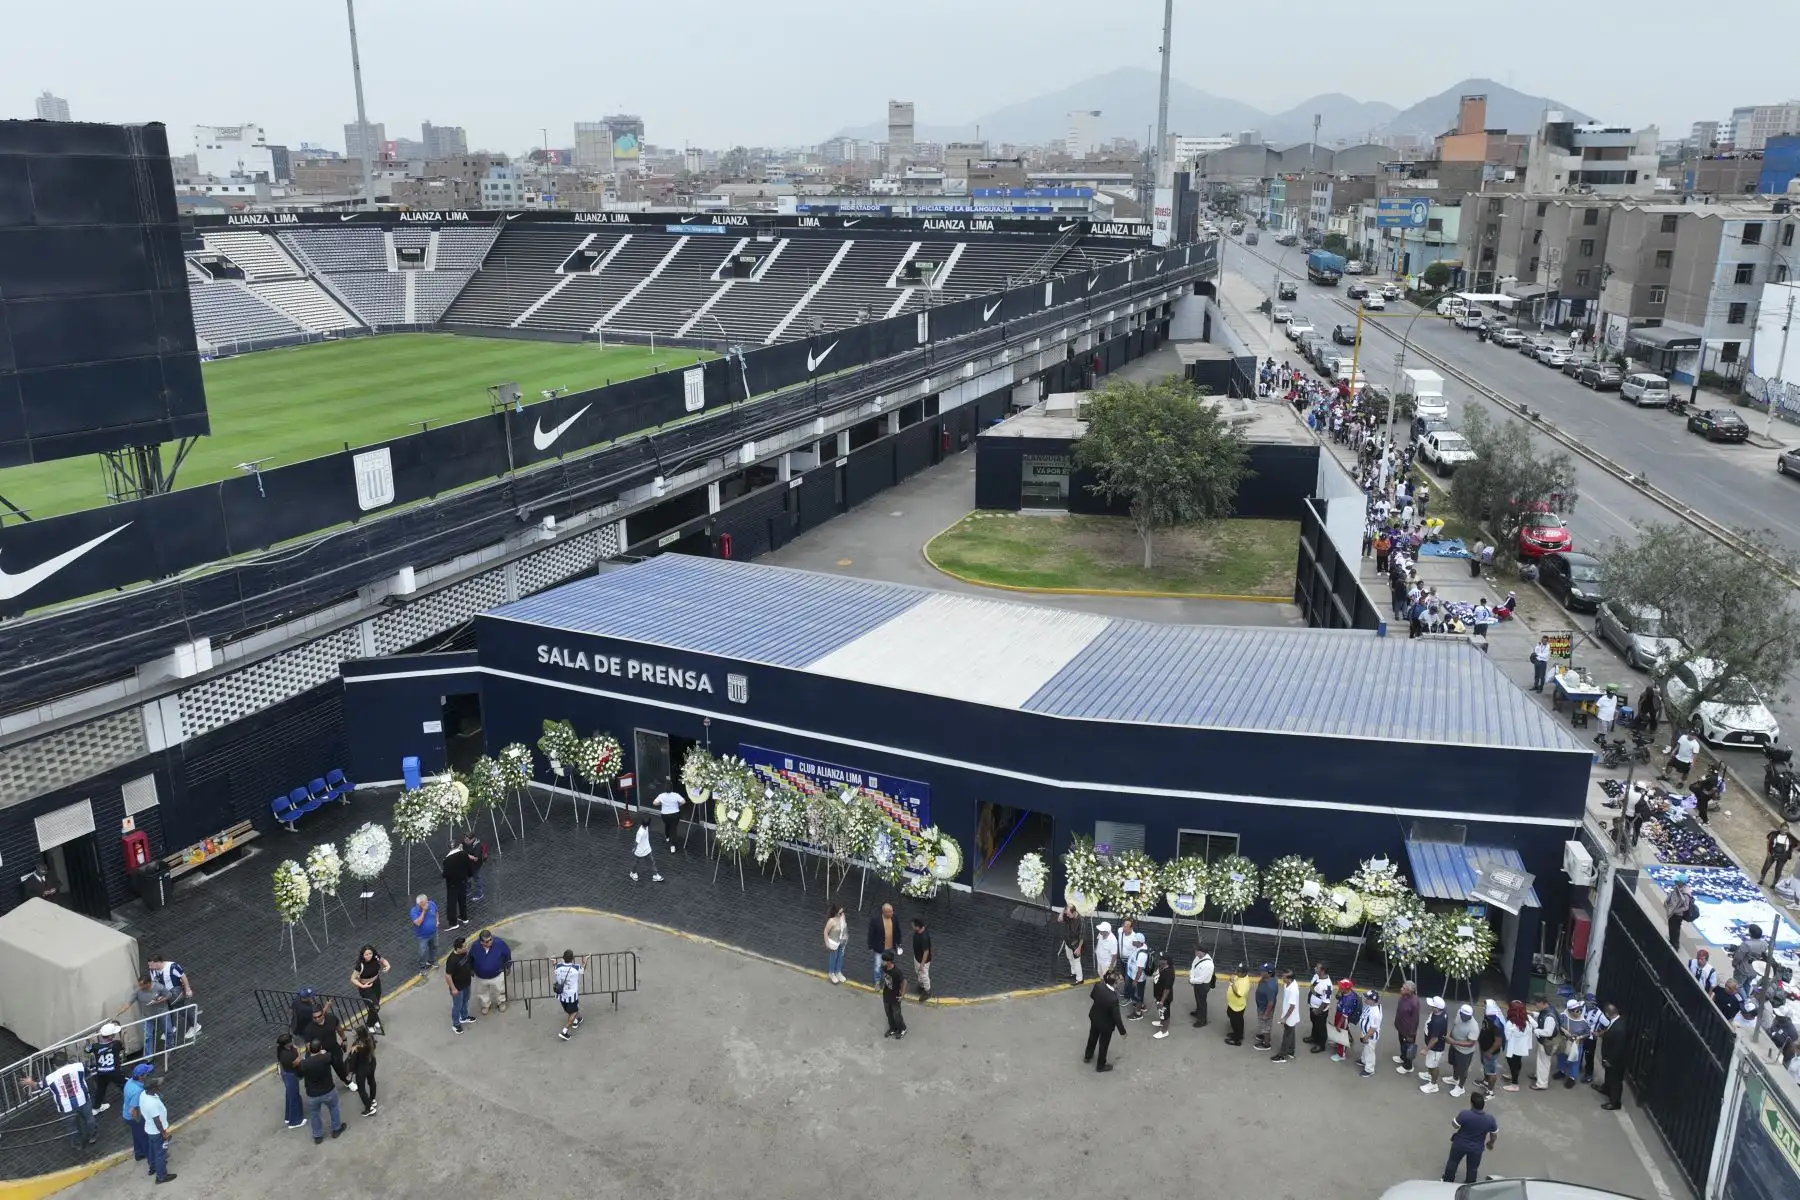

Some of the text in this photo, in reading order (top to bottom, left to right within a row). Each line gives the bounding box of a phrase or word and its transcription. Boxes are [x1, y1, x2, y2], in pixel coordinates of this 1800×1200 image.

[228, 213, 299, 225] ALIANZA LIMA
[400, 211, 469, 221] ALIANZA LIMA
[574, 213, 631, 223] ALIANZA LIMA
[711, 215, 820, 227] ALIANZA LIMA
[922, 219, 995, 231] ALIANZA LIMA
[1090, 223, 1152, 236] ALIANZA LIMA
[537, 644, 590, 671] SALA
[593, 653, 622, 677] DE
[627, 658, 715, 695] PRENSA
[799, 761, 863, 785] CLUB ALIANZA LIMA
[98, 1053, 114, 1067] 48
[1775, 1120, 1800, 1166] SAL
